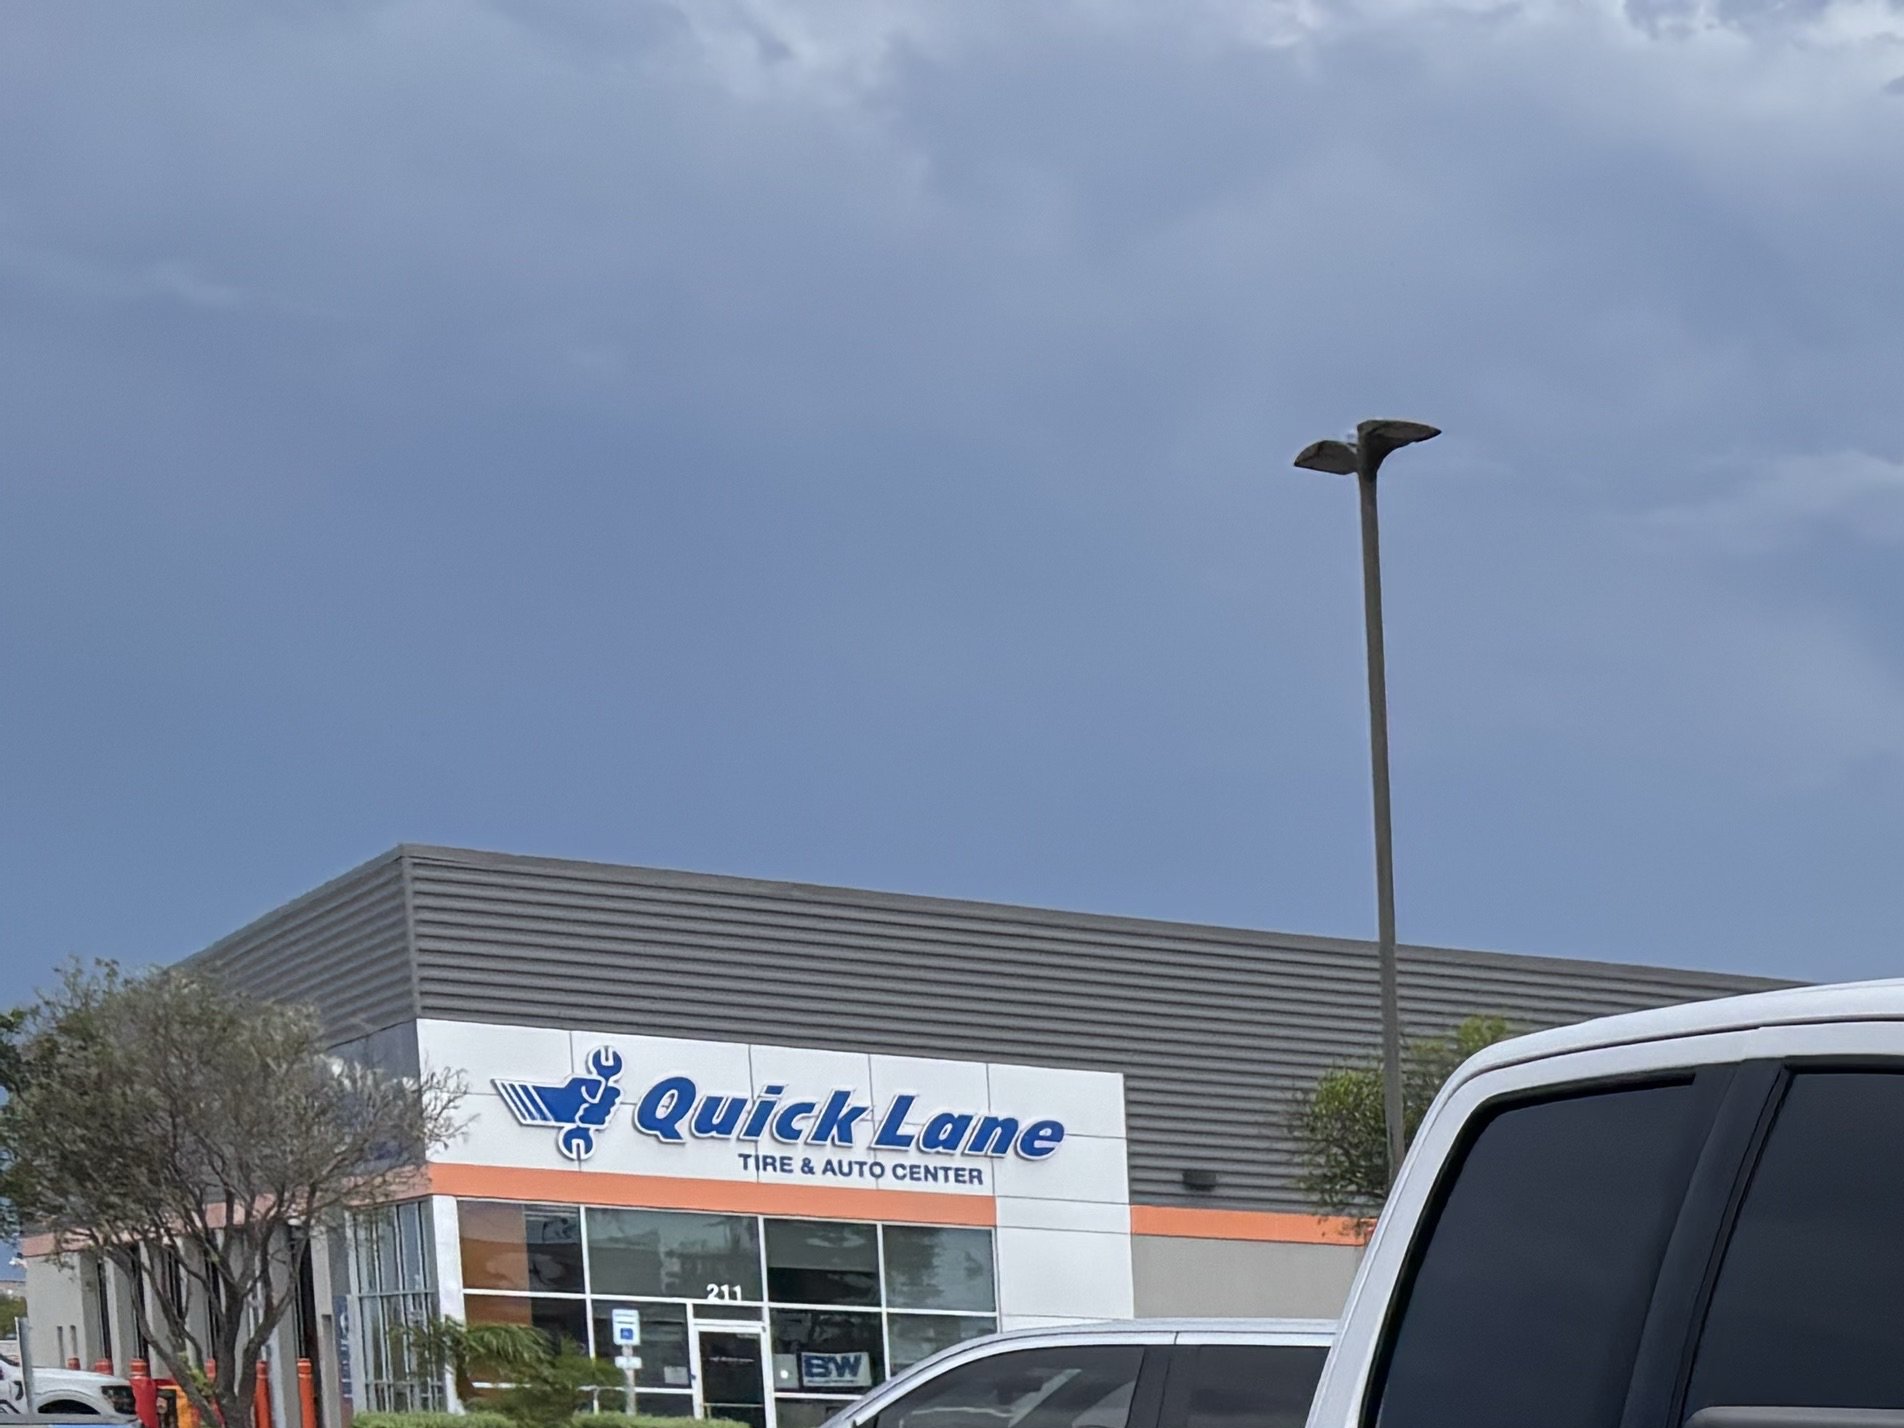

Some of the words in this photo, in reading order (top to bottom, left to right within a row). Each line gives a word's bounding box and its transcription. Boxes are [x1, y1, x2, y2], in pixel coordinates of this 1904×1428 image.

[635, 1075, 870, 1146] Quick
[871, 1093, 1067, 1160] Lane
[738, 1153, 794, 1174] TIRE
[800, 1157, 815, 1175] &
[822, 1158, 886, 1178] AUTO
[892, 1163, 984, 1186] CENTER
[706, 1283, 743, 1301] 211
